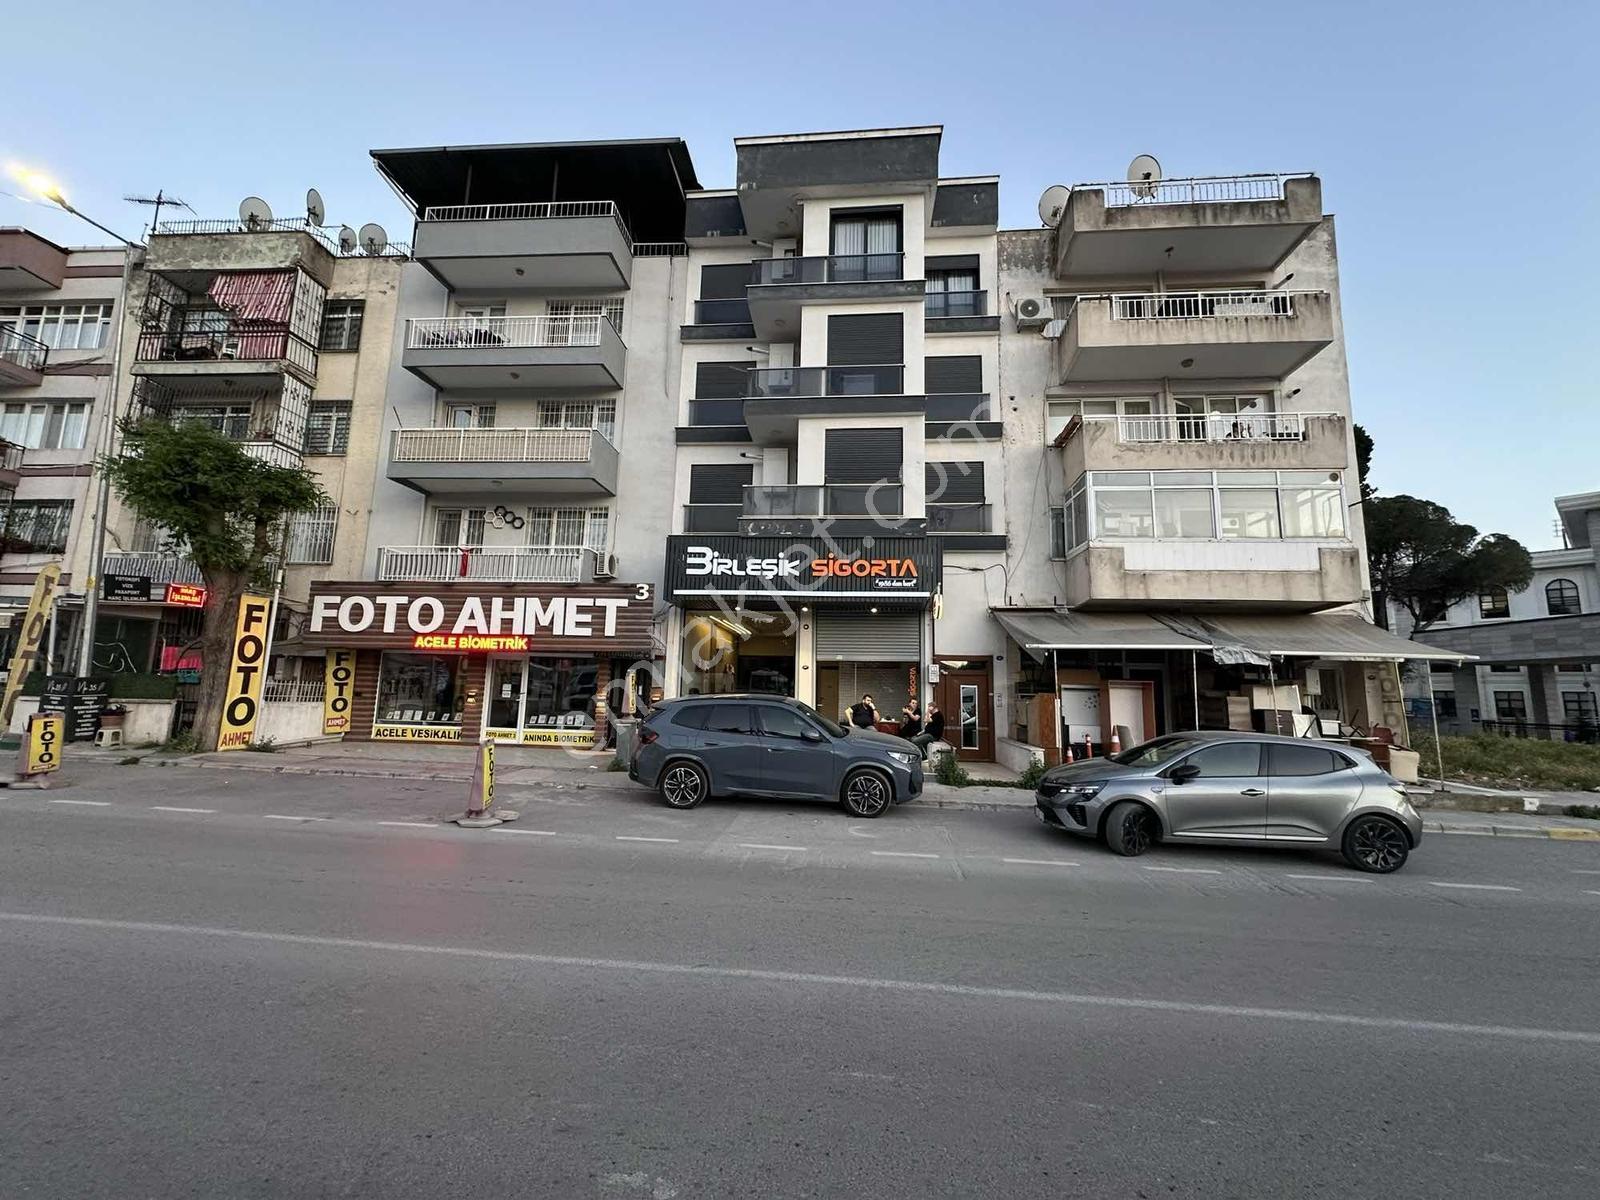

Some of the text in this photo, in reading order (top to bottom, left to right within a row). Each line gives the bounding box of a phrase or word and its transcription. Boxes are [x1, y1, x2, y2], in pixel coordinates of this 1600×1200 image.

[309, 584, 650, 637] FOTO AHMET 3
[414, 636, 457, 649] ACELE
[226, 603, 265, 727] FOTO
[331, 651, 351, 713] FOTO
[38, 720, 55, 764] FOTO
[220, 731, 253, 748] AHMET
[375, 728, 408, 738] ACELE
[523, 734, 552, 742] ANINDA
